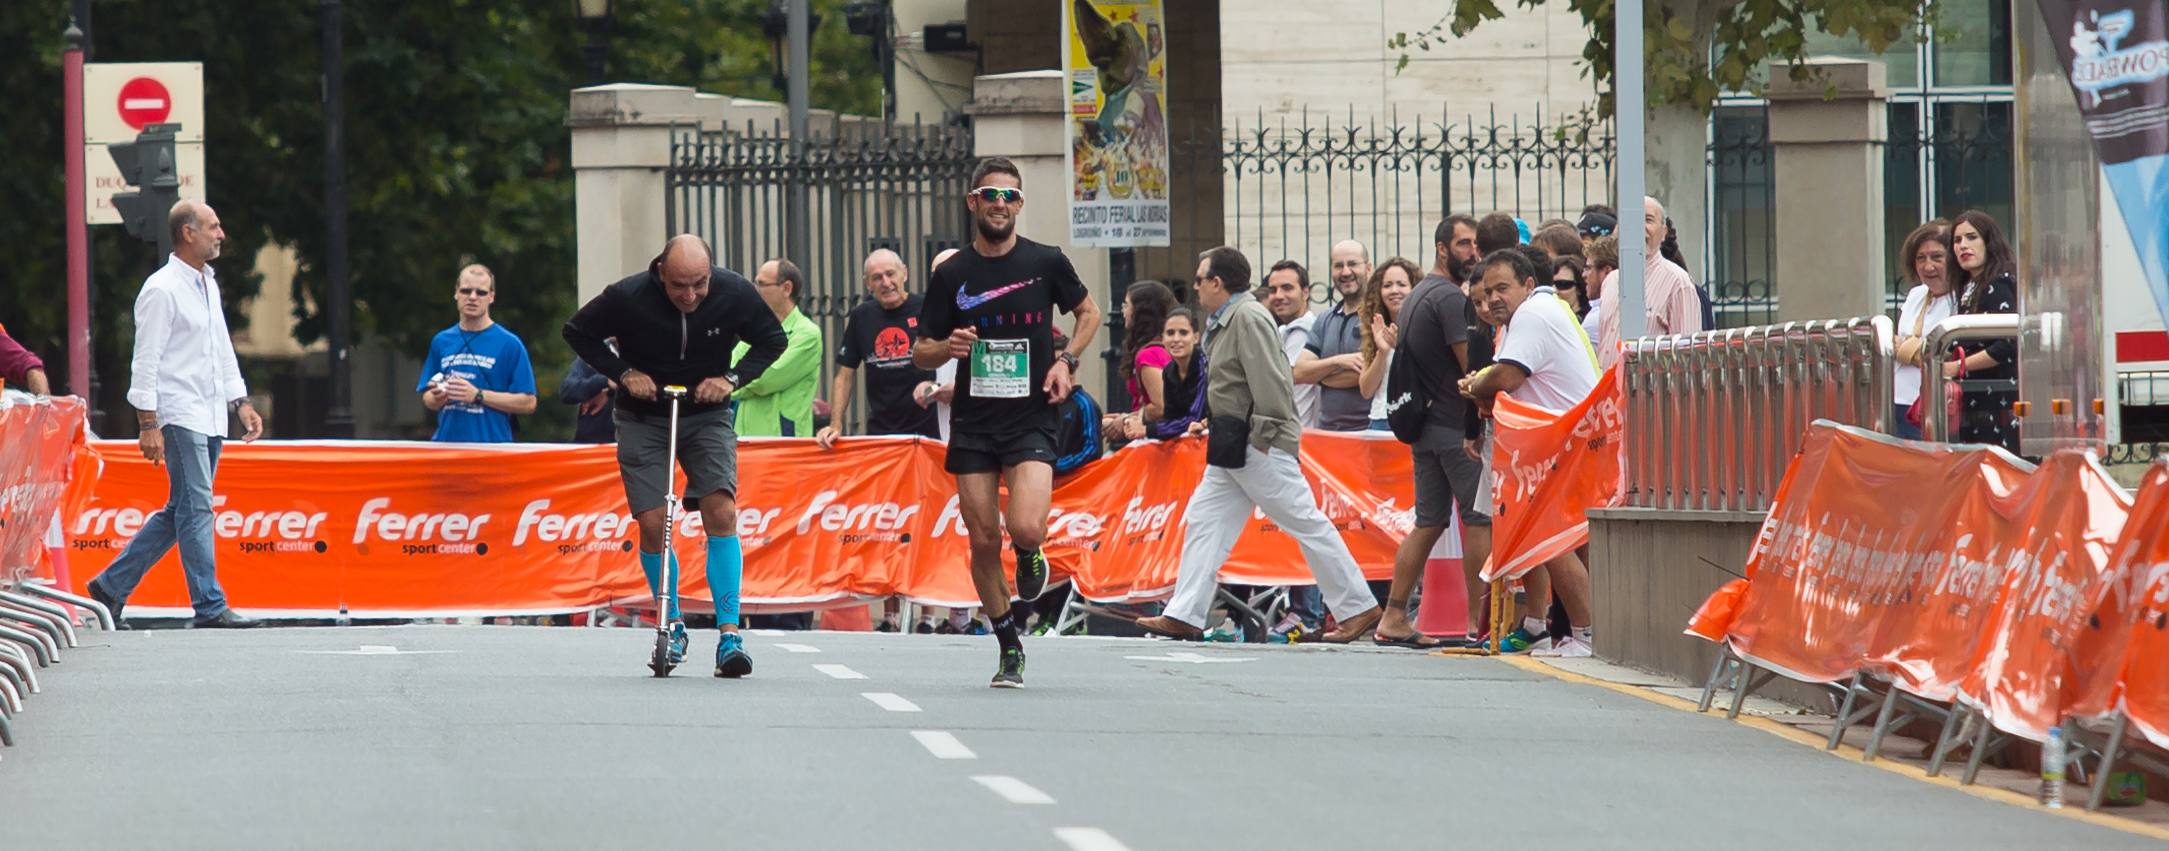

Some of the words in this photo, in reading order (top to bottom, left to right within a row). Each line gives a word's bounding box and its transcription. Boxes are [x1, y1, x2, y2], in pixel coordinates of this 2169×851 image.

[1073, 206, 1107, 224] RECINTO
[981, 354, 1017, 373] 184
[72, 538, 109, 551] sport
[239, 540, 275, 553] sport
[276, 540, 315, 553] center
[402, 542, 437, 556] sport
[437, 541, 476, 555] center
[557, 542, 588, 557] sport
